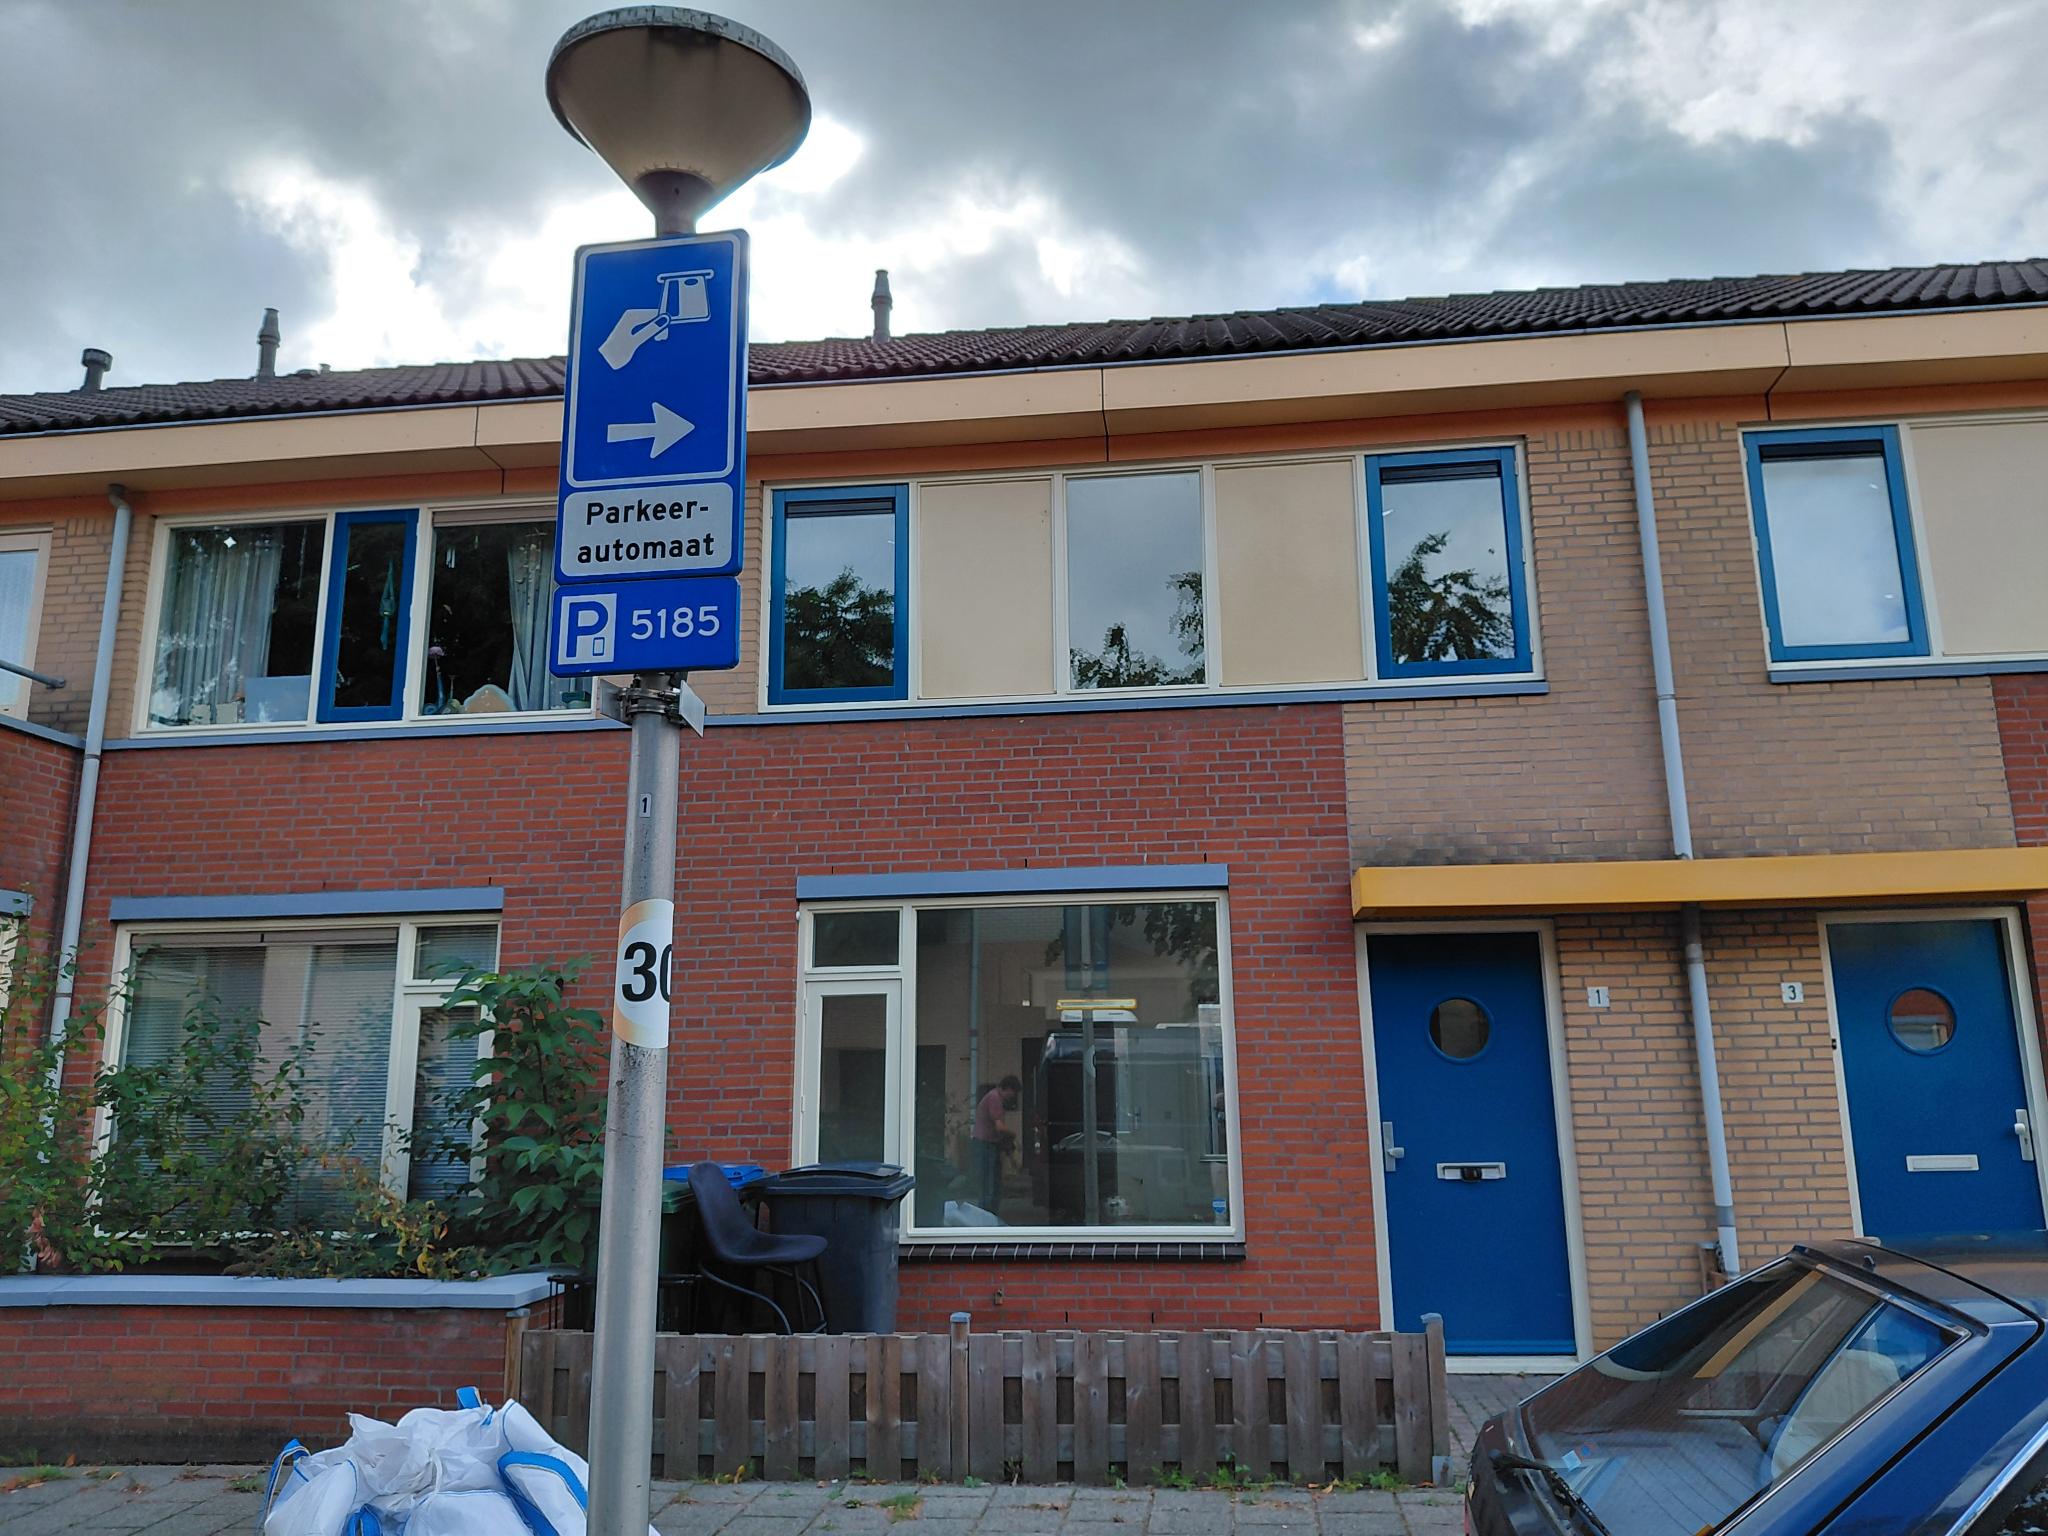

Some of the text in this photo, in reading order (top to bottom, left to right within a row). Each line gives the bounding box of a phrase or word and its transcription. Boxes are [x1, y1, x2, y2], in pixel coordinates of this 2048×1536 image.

[586, 499, 709, 525] Parkeer-
[577, 533, 714, 563] automaat
[566, 600, 720, 658] P 5185
[641, 796, 649, 814] 1
[1788, 985, 1797, 1001] 3
